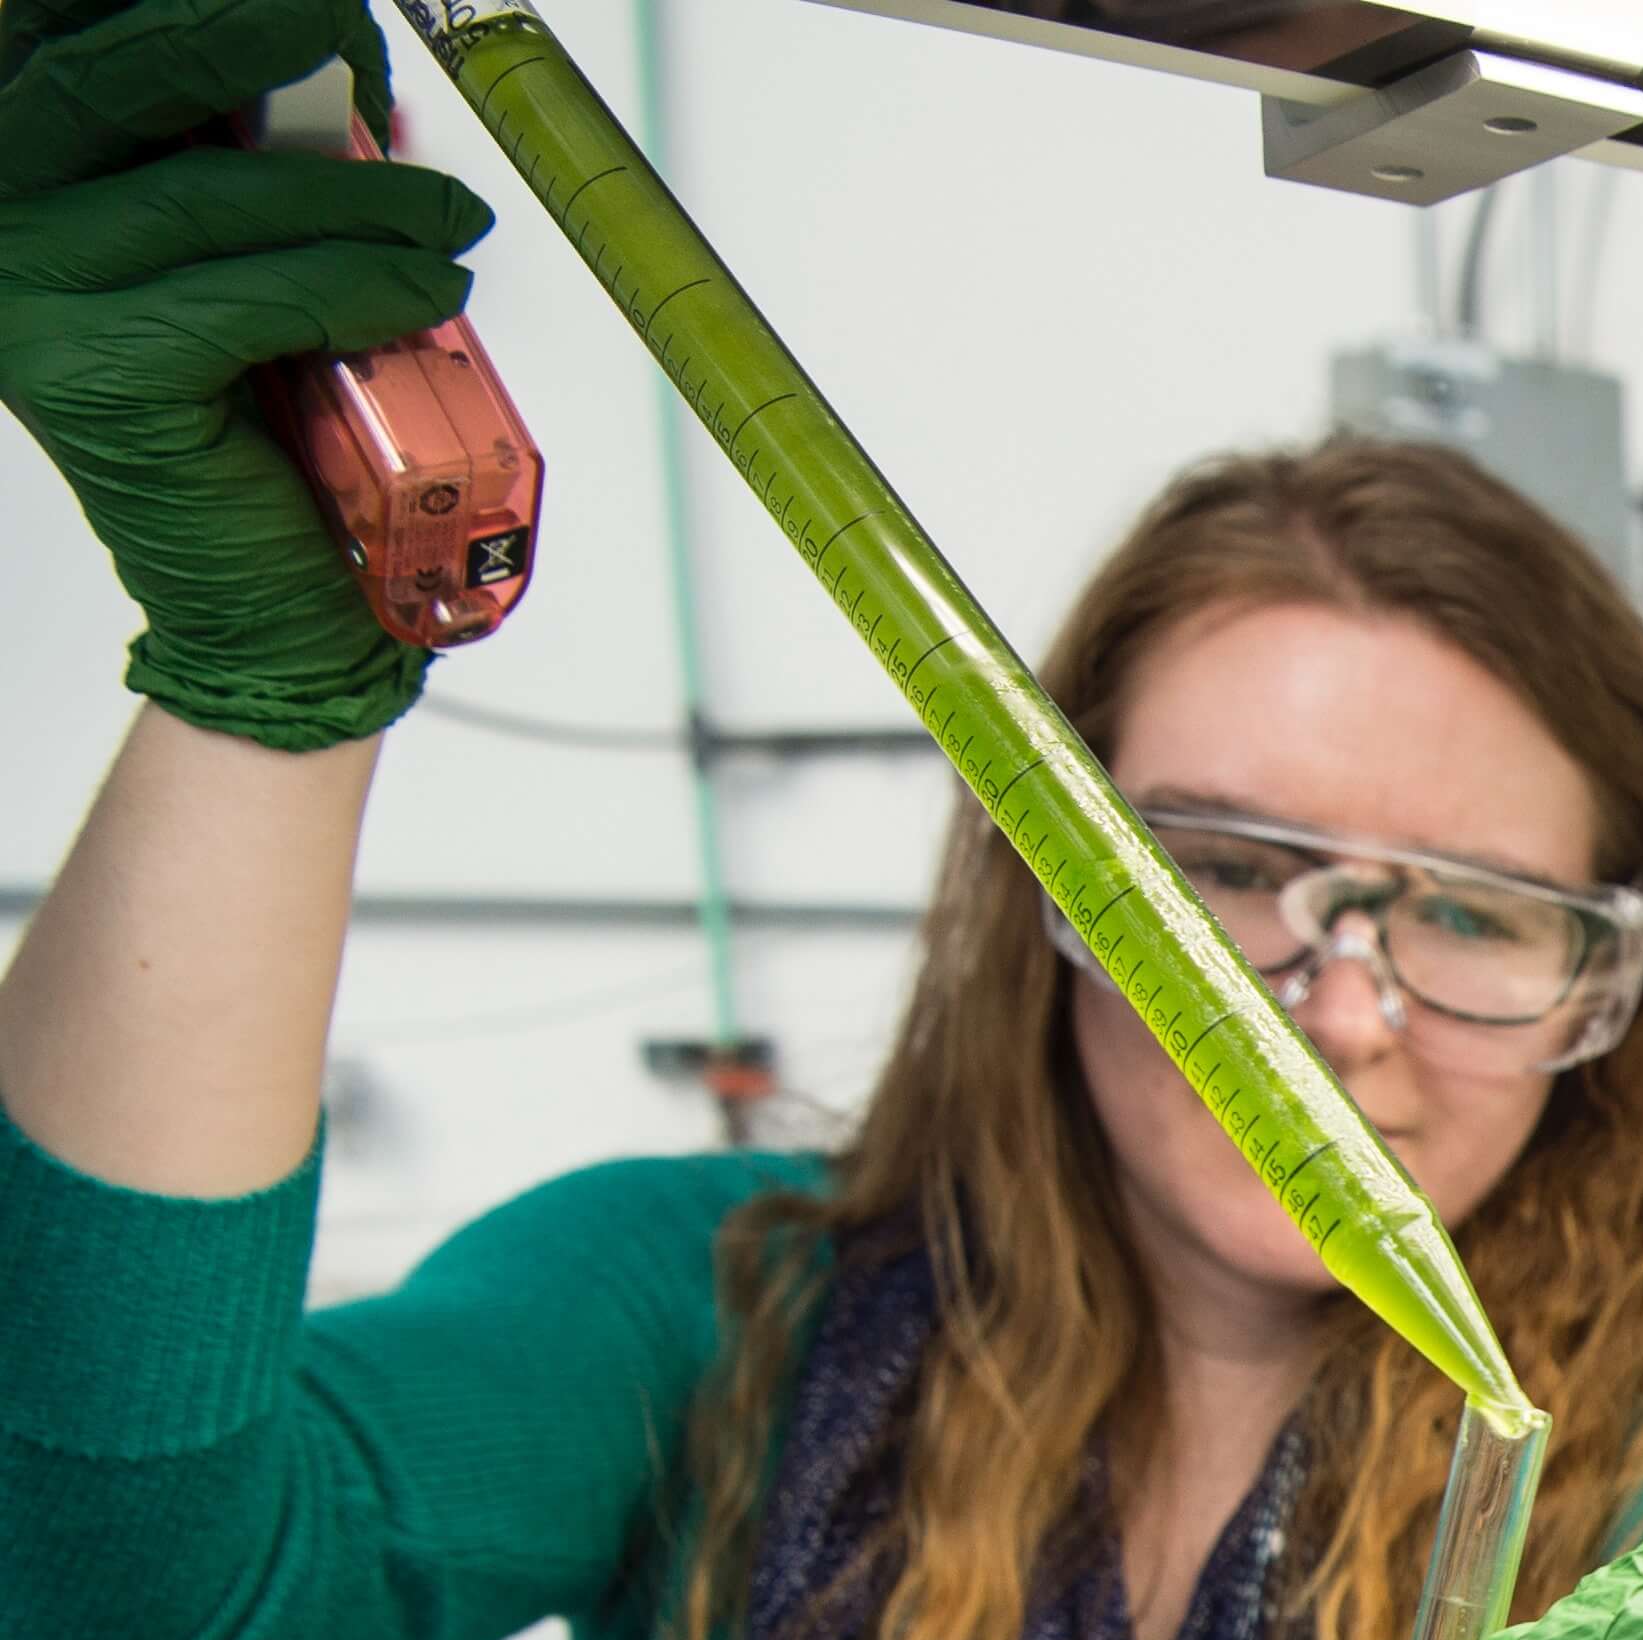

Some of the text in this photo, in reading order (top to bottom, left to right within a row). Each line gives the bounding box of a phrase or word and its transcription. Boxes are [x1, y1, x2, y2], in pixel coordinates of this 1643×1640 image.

[803, 537, 818, 569] 20
[891, 656, 908, 688] 25
[982, 778, 999, 811] 30
[1074, 902, 1092, 934] 35
[1170, 1030, 1188, 1057] 40
[1267, 1158, 1286, 1187] 45
